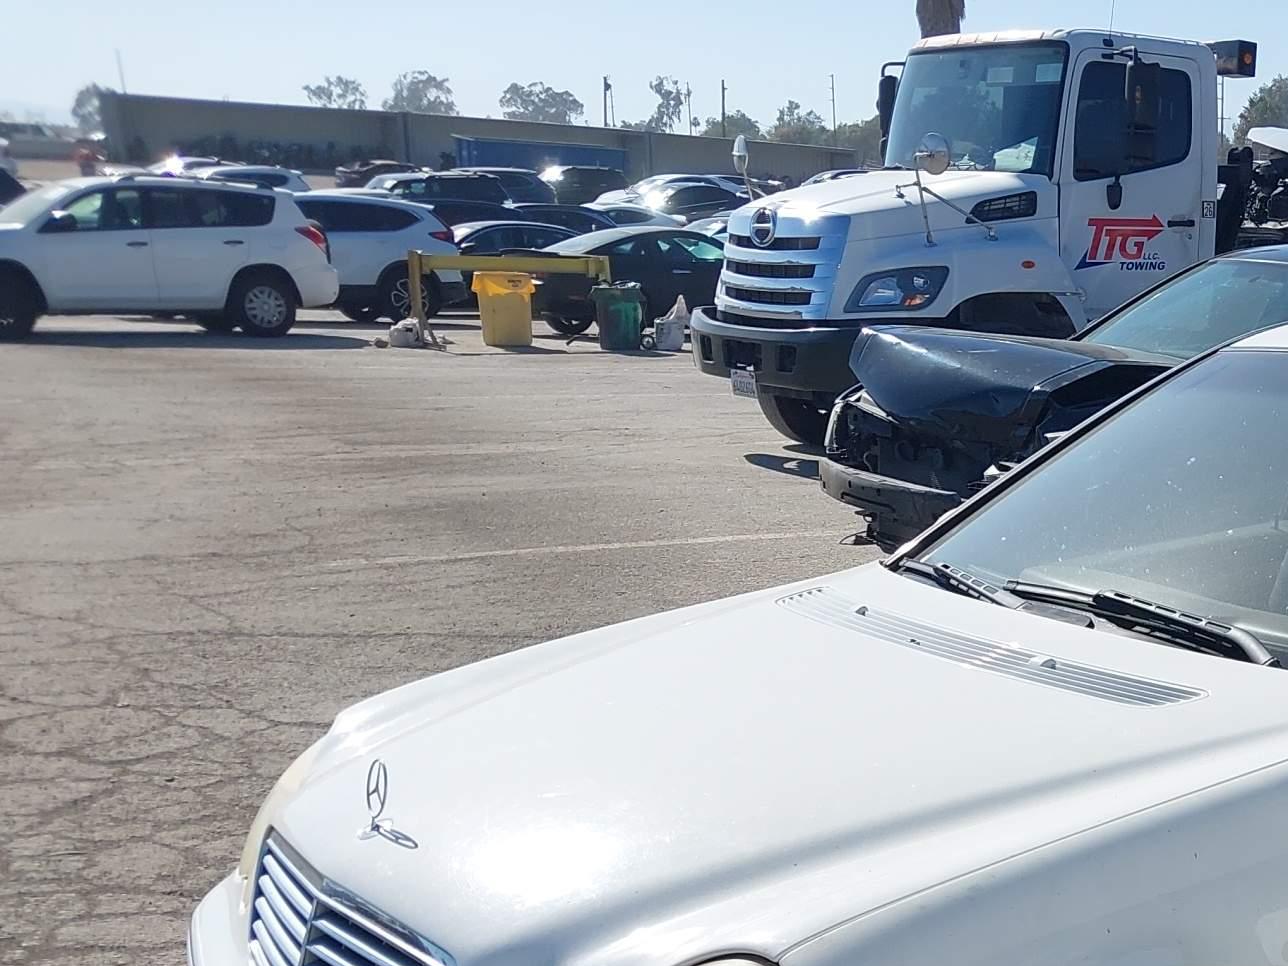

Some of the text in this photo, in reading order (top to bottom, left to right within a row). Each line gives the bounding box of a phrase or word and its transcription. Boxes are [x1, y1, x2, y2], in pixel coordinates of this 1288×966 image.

[1204, 206, 1213, 217] 26
[1087, 214, 1165, 261] TTG
[1119, 261, 1166, 271] TOWING
